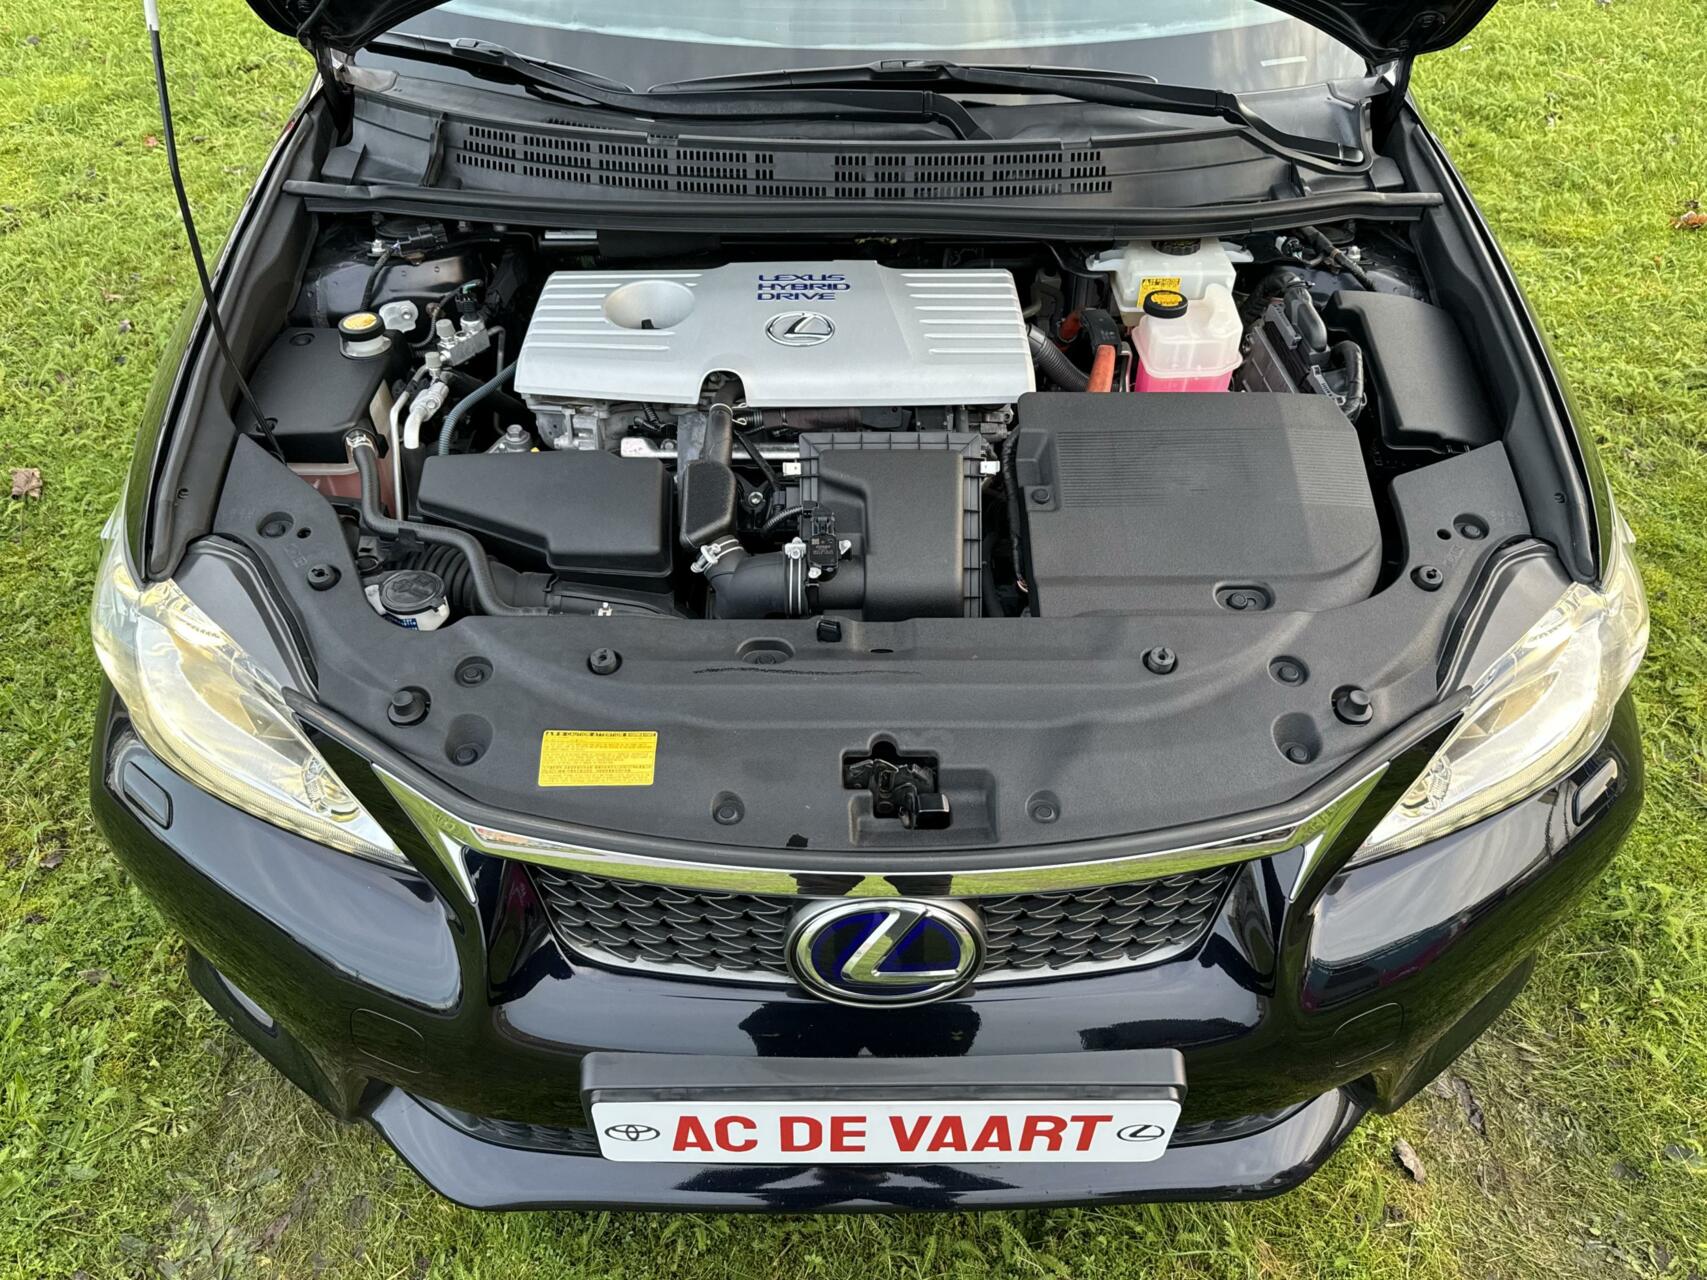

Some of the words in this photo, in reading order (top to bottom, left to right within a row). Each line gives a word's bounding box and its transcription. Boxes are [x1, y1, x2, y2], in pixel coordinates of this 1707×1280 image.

[757, 283, 850, 291] HYBRID
[757, 292, 836, 300] DRIVE
[672, 1116, 757, 1152] AC
[779, 1116, 867, 1152] DE
[889, 1115, 1113, 1152] VAART
